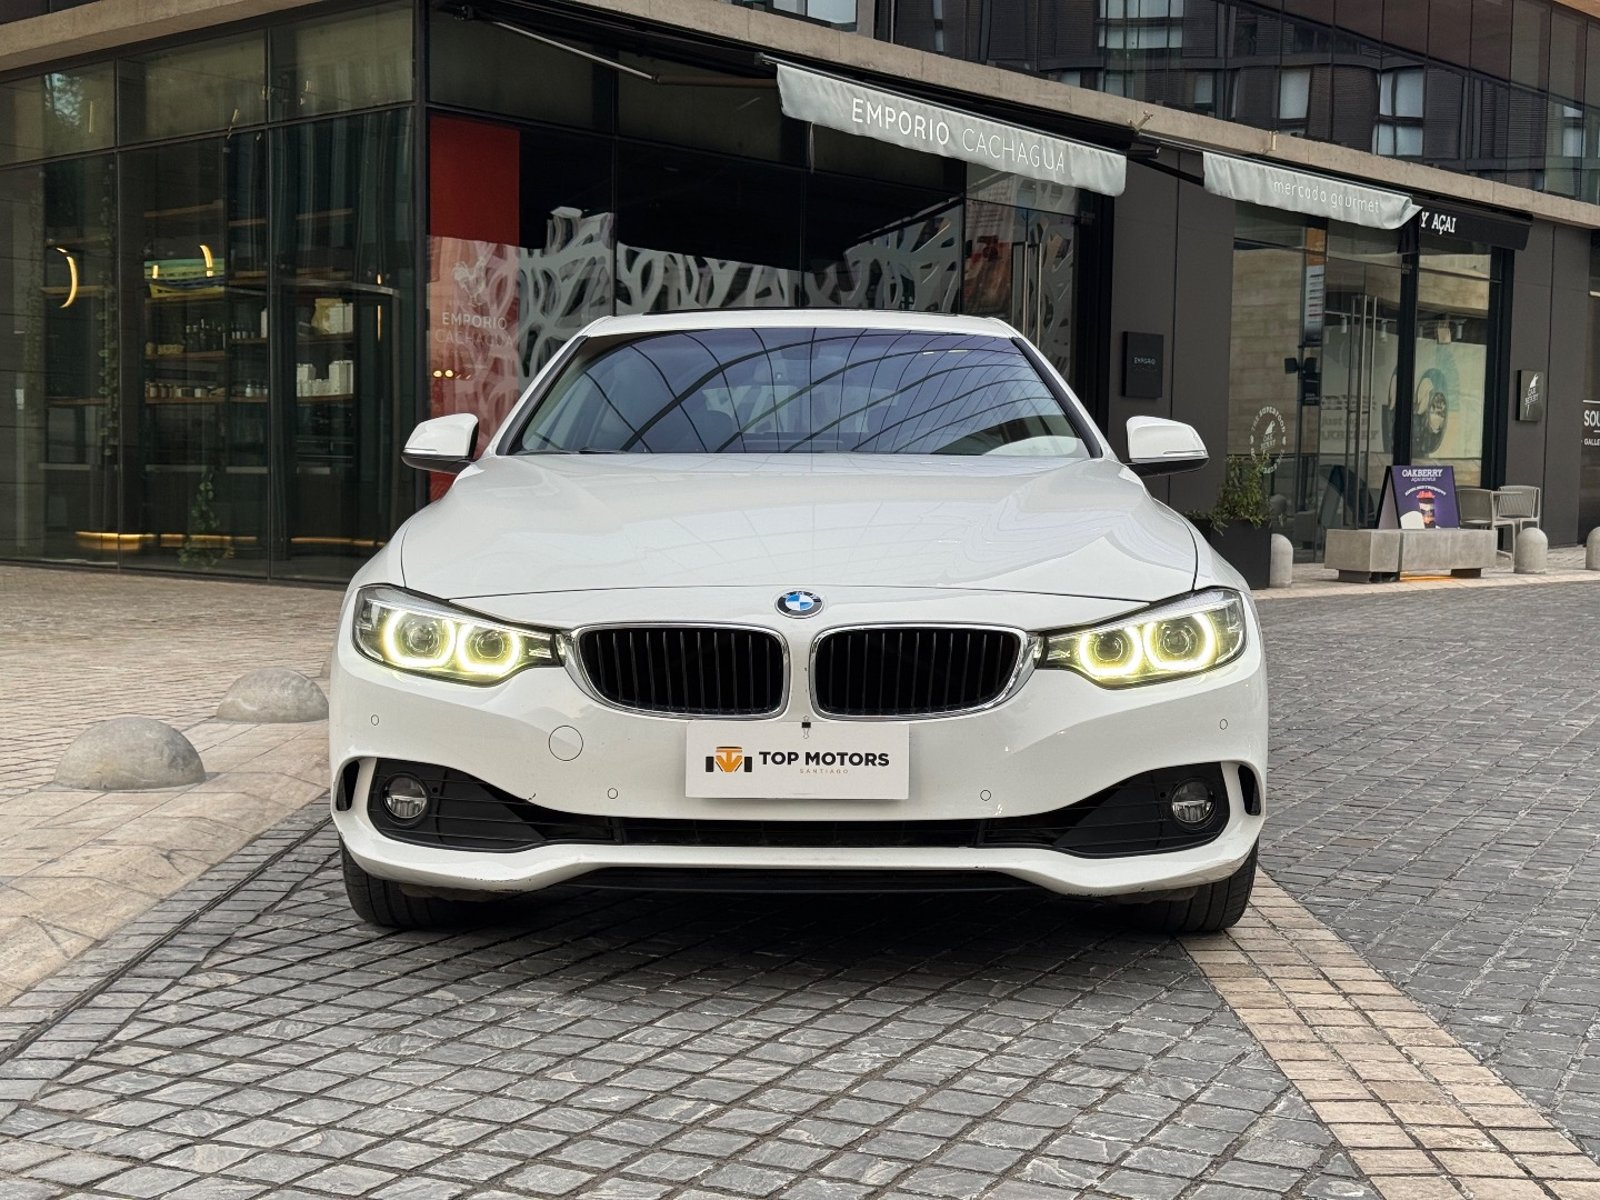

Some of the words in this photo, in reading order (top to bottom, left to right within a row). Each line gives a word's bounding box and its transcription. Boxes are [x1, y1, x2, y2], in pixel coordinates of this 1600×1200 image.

[851, 97, 949, 145] EMPORIO
[962, 128, 1066, 174] CACHAGUA
[1273, 180, 1327, 203] mercado
[1330, 192, 1381, 214] gourmet
[1431, 212, 1457, 235] AÇAI
[441, 311, 508, 331] EMPORIO
[1401, 468, 1444, 478] OAKBERRY
[758, 750, 800, 766] TOP
[804, 751, 890, 768] MOTORS
